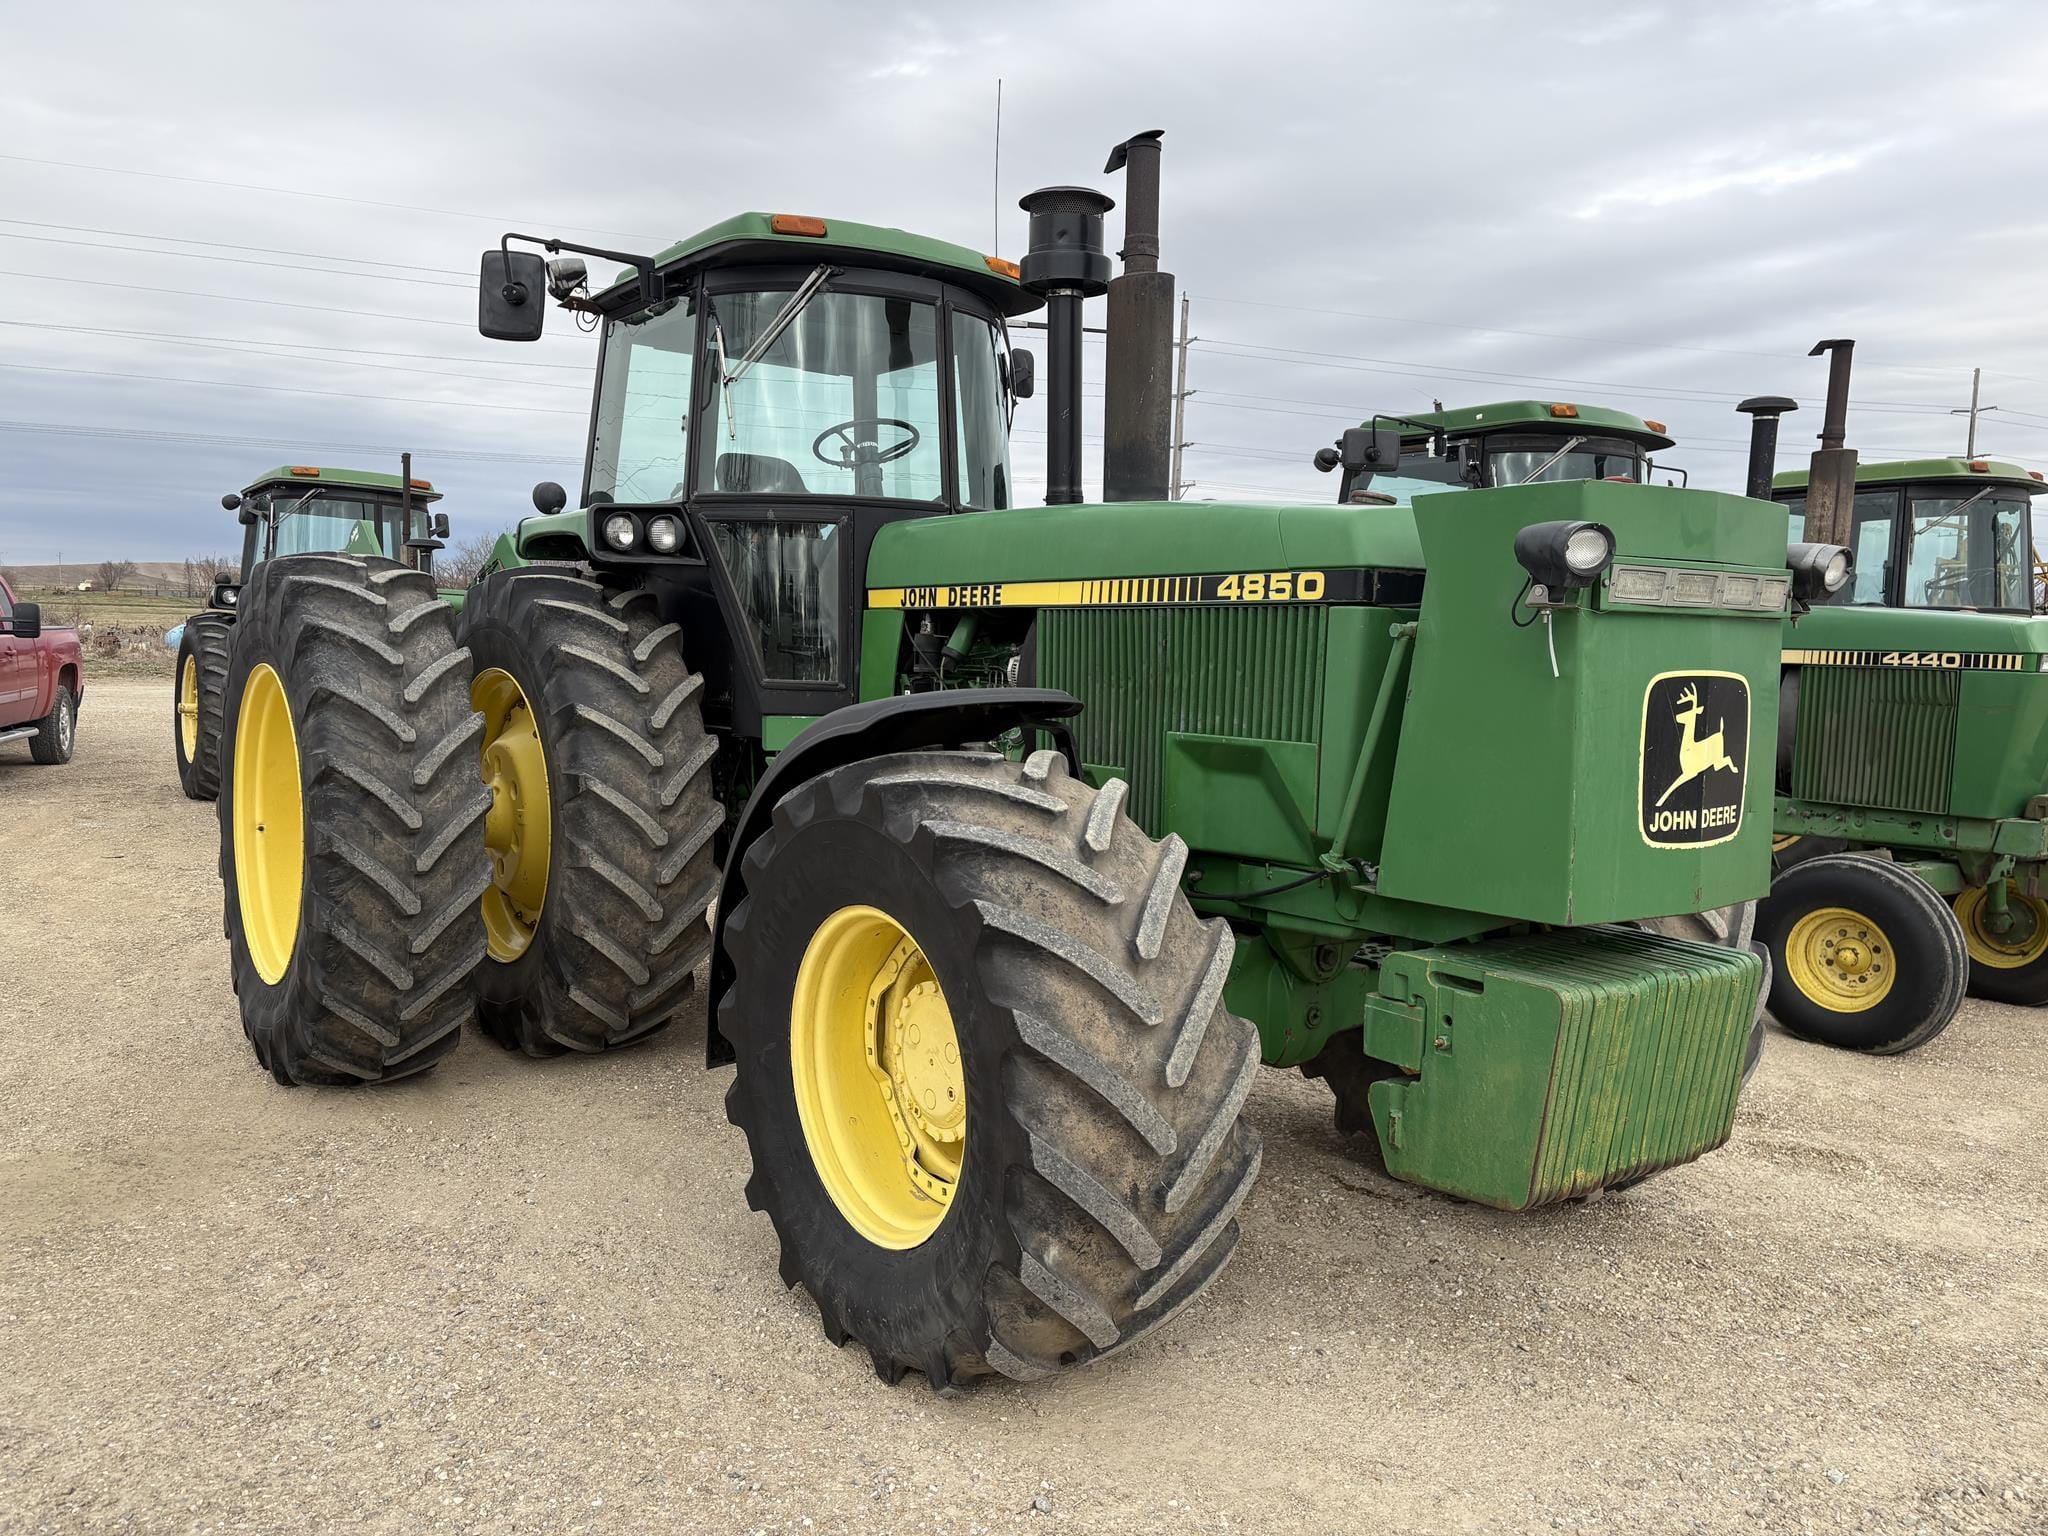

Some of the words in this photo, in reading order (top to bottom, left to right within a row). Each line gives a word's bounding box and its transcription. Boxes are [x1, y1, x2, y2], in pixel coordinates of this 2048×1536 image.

[900, 587, 937, 607] JOHN
[948, 585, 1002, 606] DEERE
[1217, 571, 1325, 601] 4850
[1882, 652, 1961, 669] 4440
[1649, 810, 1697, 833] JOHN
[1701, 804, 1737, 829] DEERE
